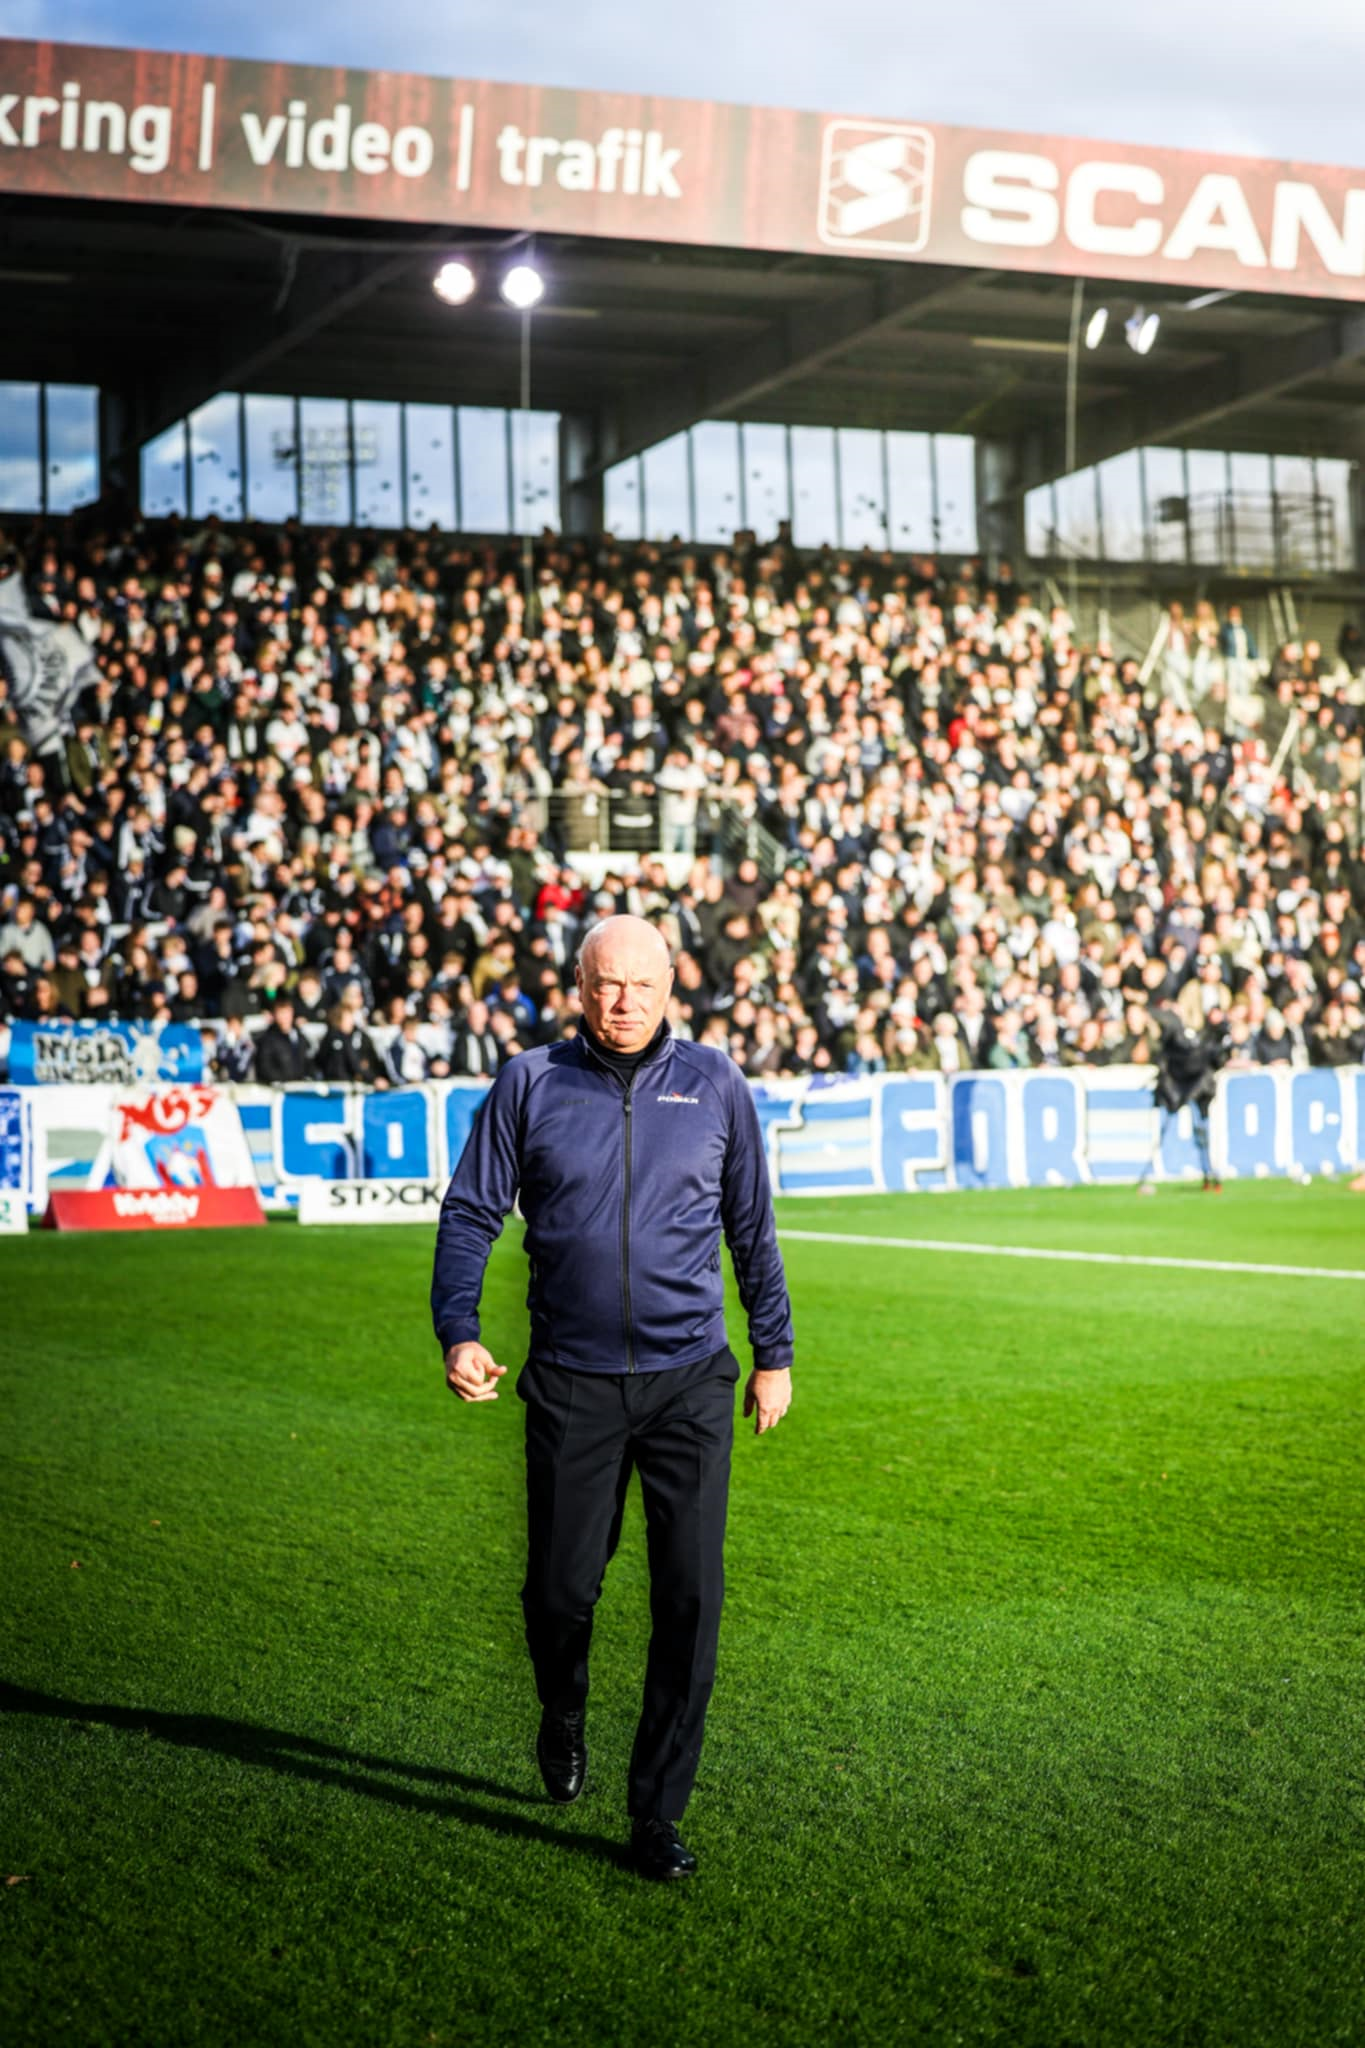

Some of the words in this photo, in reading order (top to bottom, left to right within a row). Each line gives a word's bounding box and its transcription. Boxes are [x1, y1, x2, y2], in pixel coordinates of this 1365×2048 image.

[240, 101, 434, 178] video
[497, 126, 683, 199] trafik
[961, 149, 1365, 277] SCAN
[881, 1078, 1084, 1192] FOR
